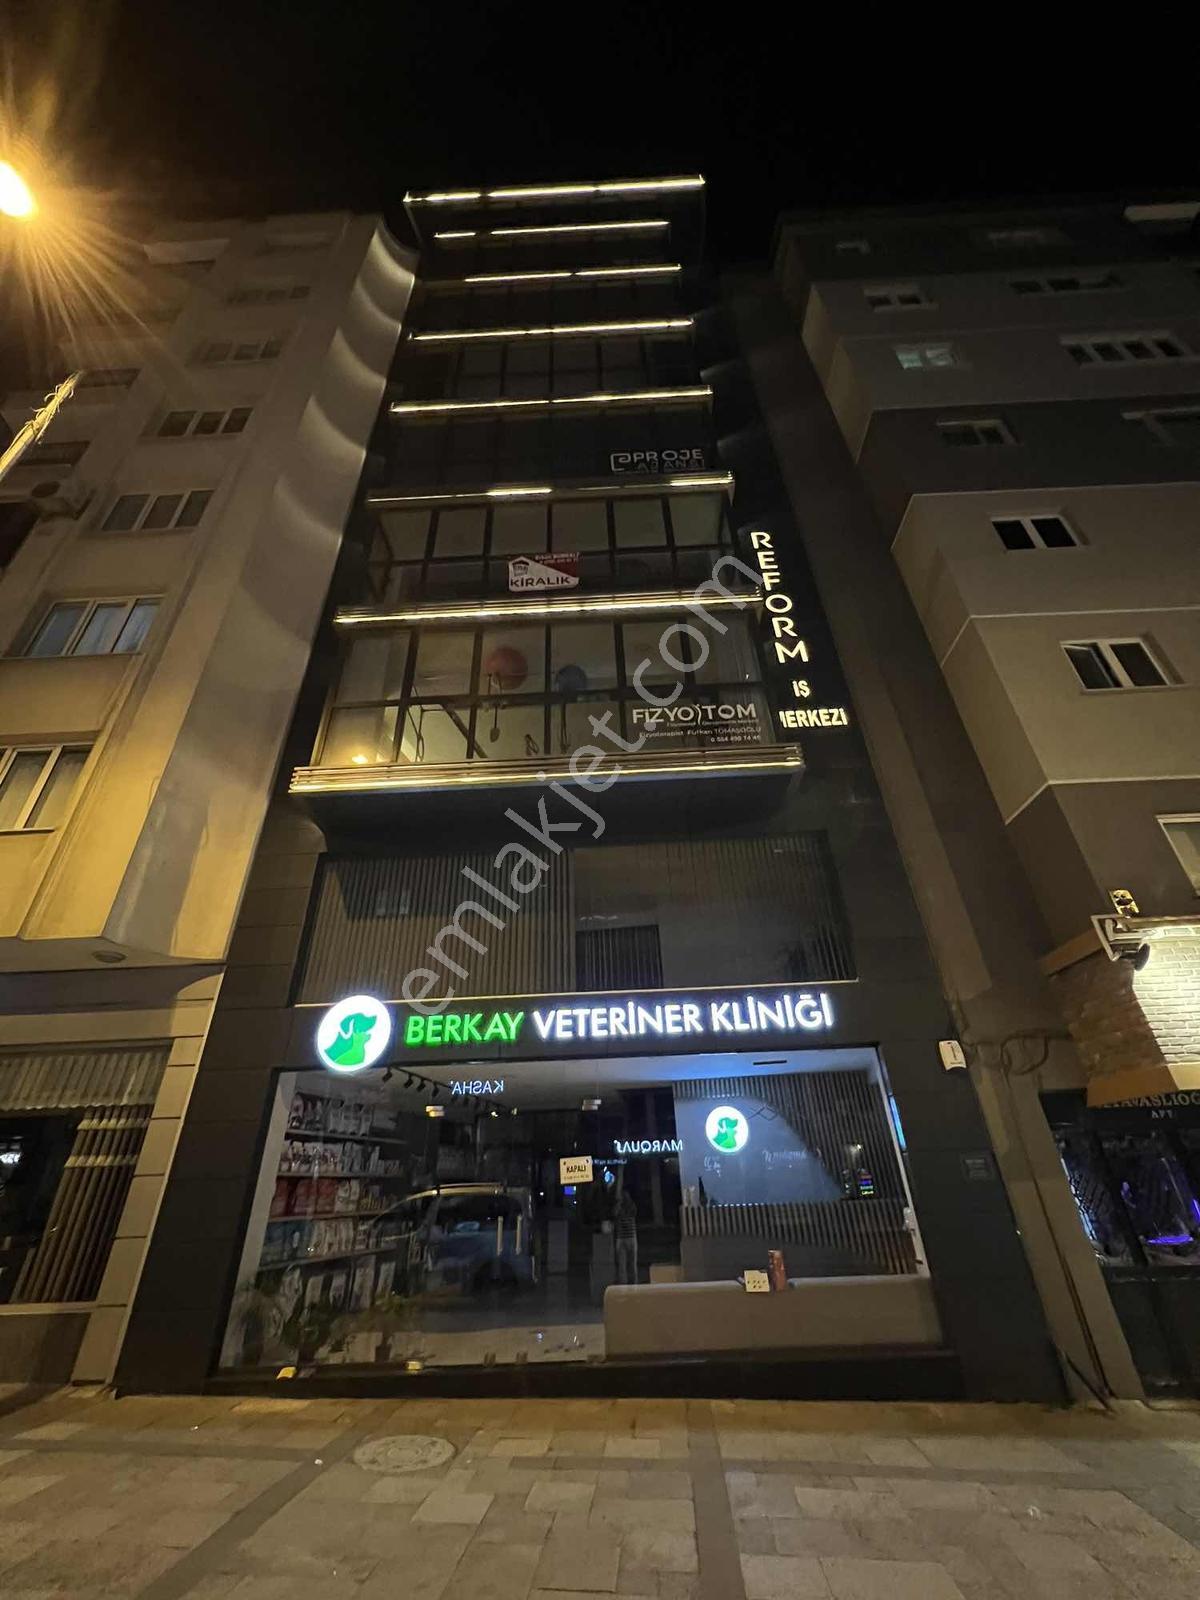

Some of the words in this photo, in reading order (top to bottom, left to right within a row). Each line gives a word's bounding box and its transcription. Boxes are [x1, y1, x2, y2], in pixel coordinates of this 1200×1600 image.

[633, 449, 703, 463] PROJE
[750, 531, 809, 664] REFORM
[405, 1011, 524, 1044] BERKAY
[531, 1001, 703, 1040] VETERİNER
